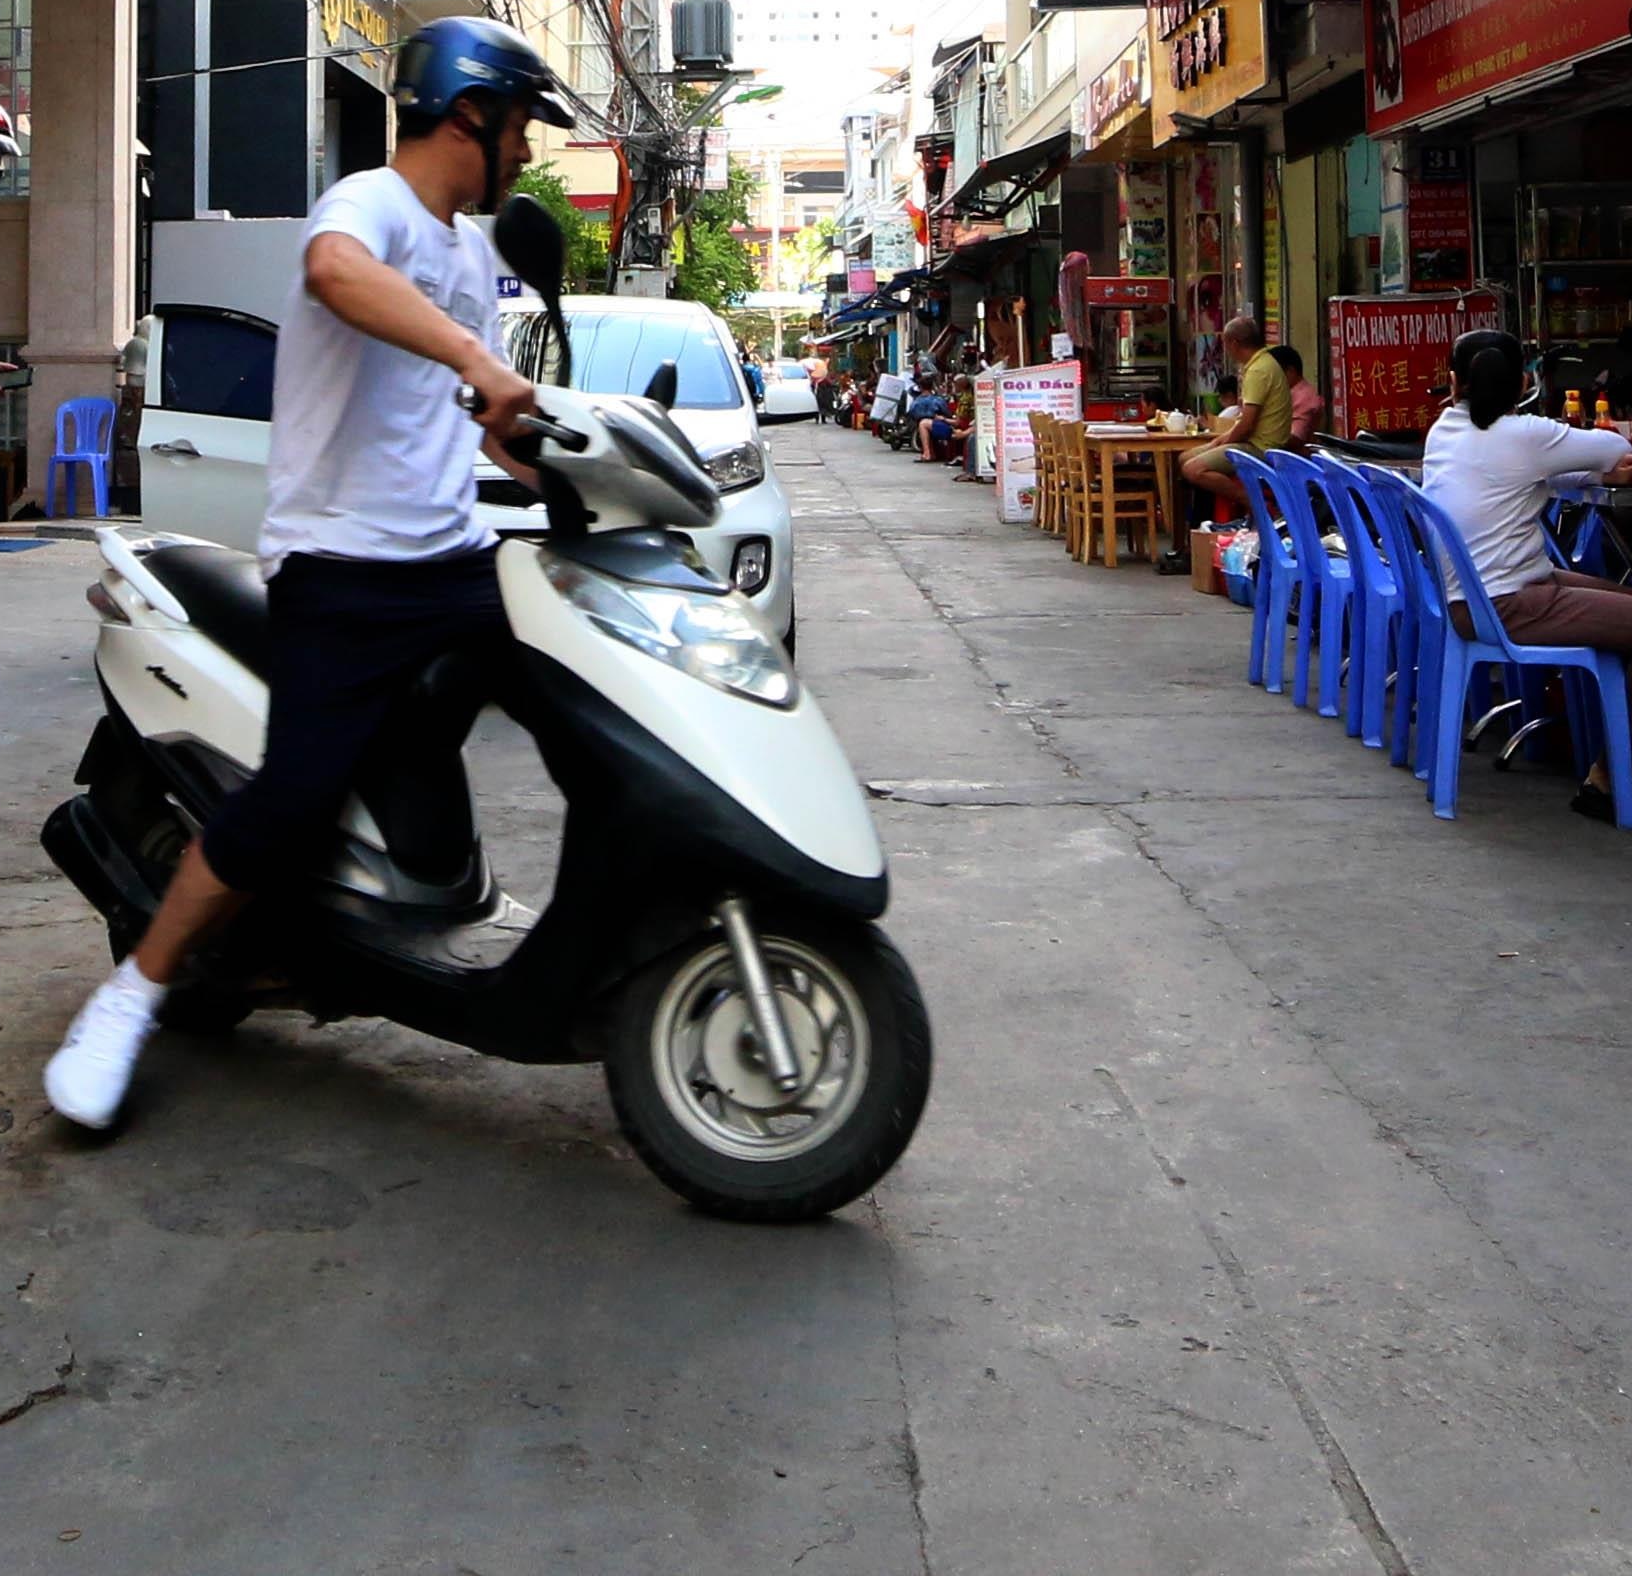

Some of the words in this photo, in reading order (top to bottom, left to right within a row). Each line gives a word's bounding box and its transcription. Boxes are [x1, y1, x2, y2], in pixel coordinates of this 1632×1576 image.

[1345, 304, 1369, 348] CỬA
[1370, 306, 1401, 347] HÀNG
[1401, 313, 1423, 352] TẠP
